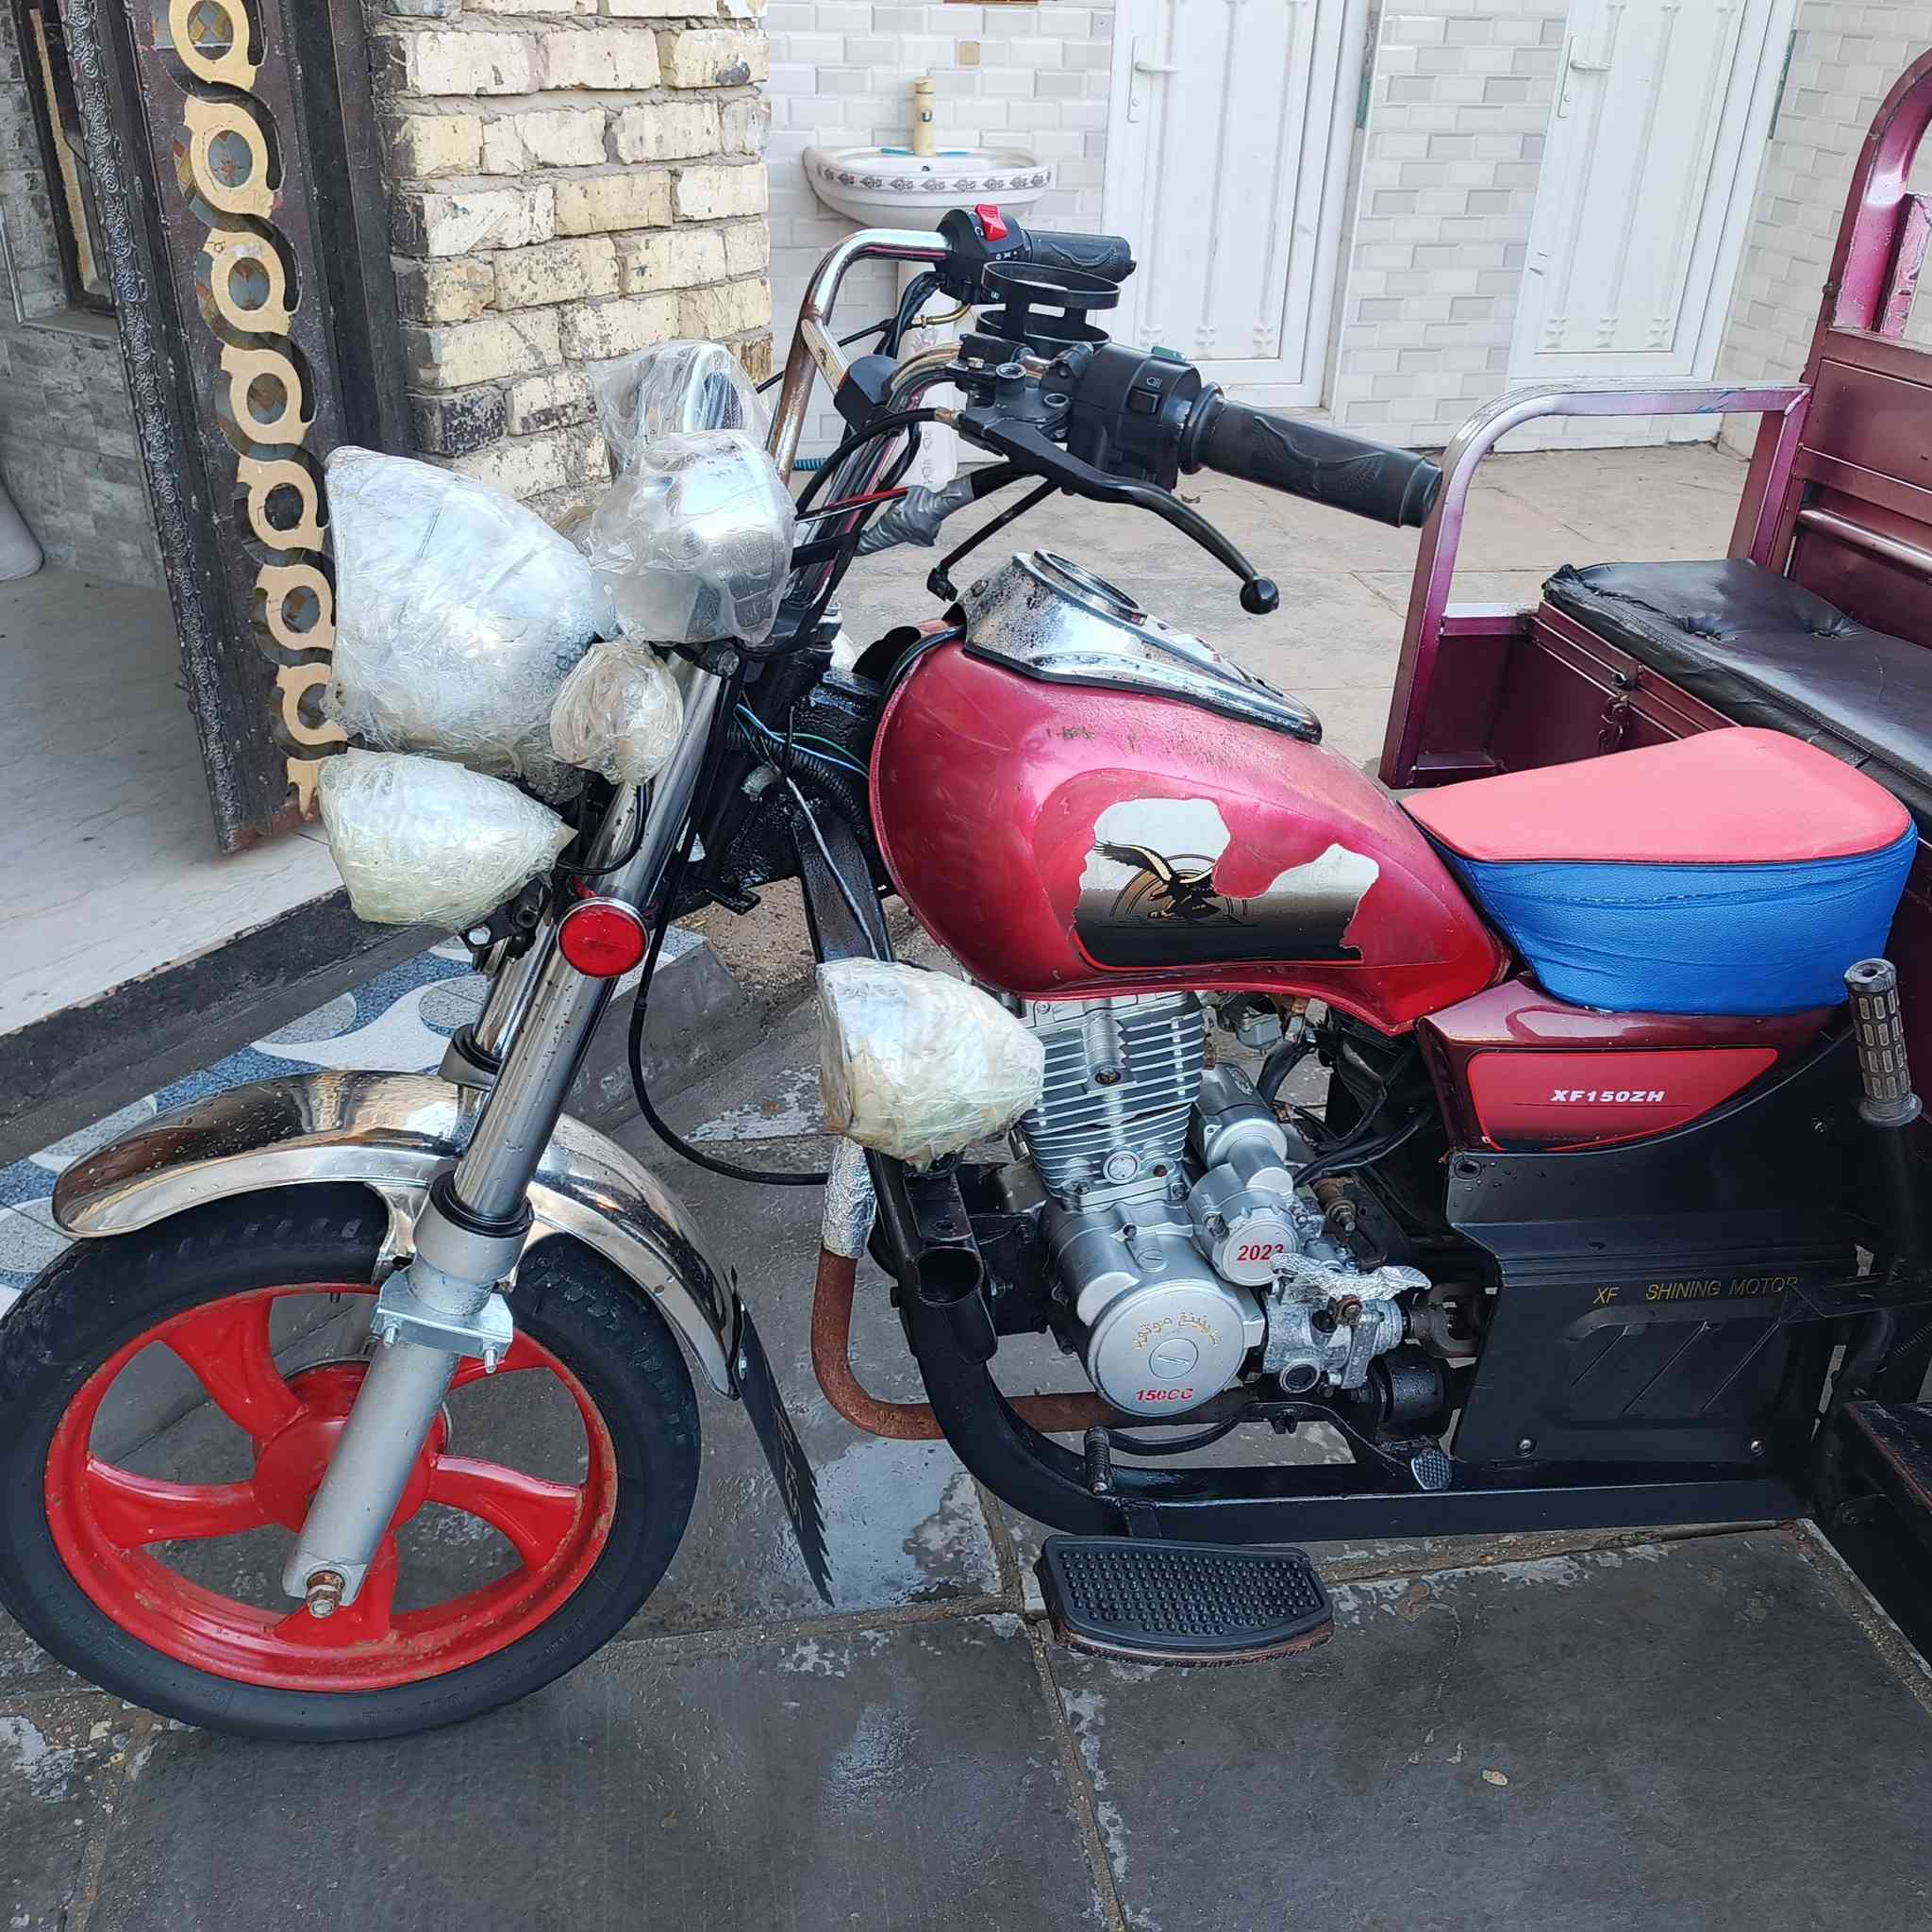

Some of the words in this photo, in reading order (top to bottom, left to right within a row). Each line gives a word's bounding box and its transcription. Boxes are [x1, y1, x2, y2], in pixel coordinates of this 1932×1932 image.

[1550, 1090, 1665, 1102] XF150ZH
[1592, 1287, 1620, 1304] XF
[1645, 1279, 1722, 1300] SHINING
[1136, 1388, 1193, 1401] 150CC
